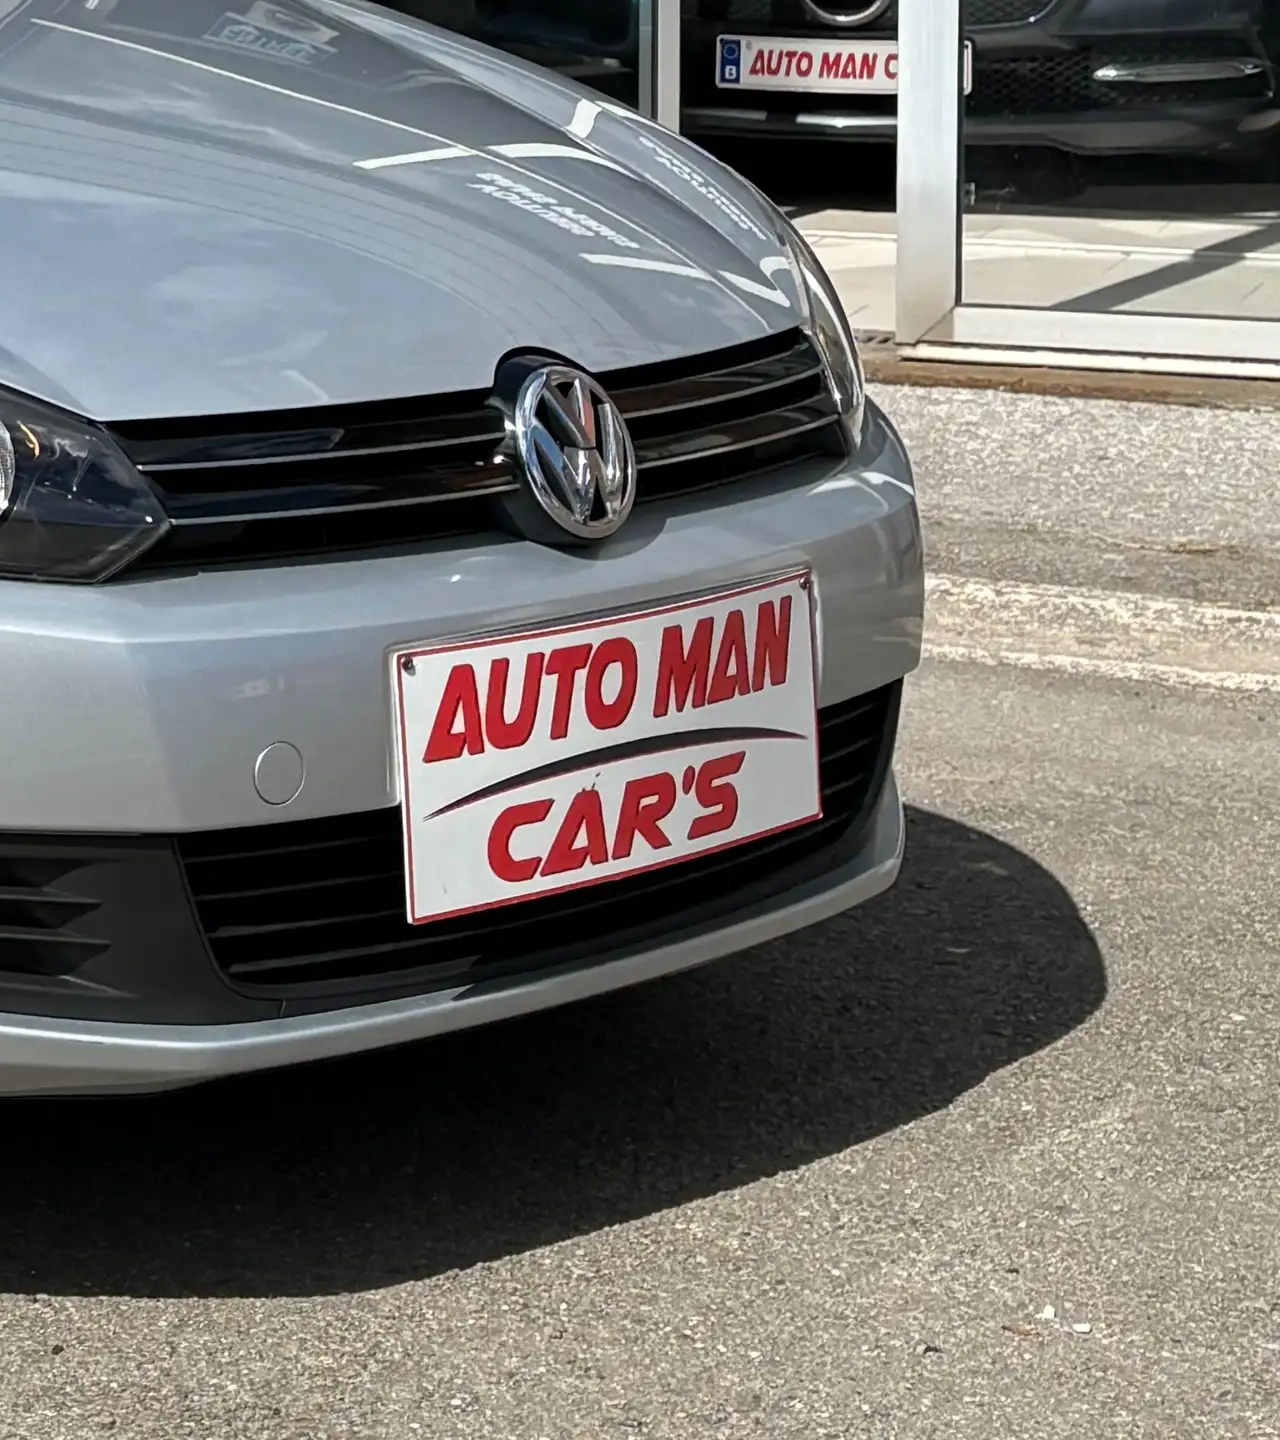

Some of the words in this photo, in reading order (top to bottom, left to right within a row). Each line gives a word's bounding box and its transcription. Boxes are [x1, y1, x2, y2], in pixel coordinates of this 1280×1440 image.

[749, 49, 813, 78] AUTO
[818, 52, 878, 80] MAN
[422, 637, 638, 764] AUTO
[653, 595, 793, 718] MAN
[487, 751, 746, 883] CAR'S
